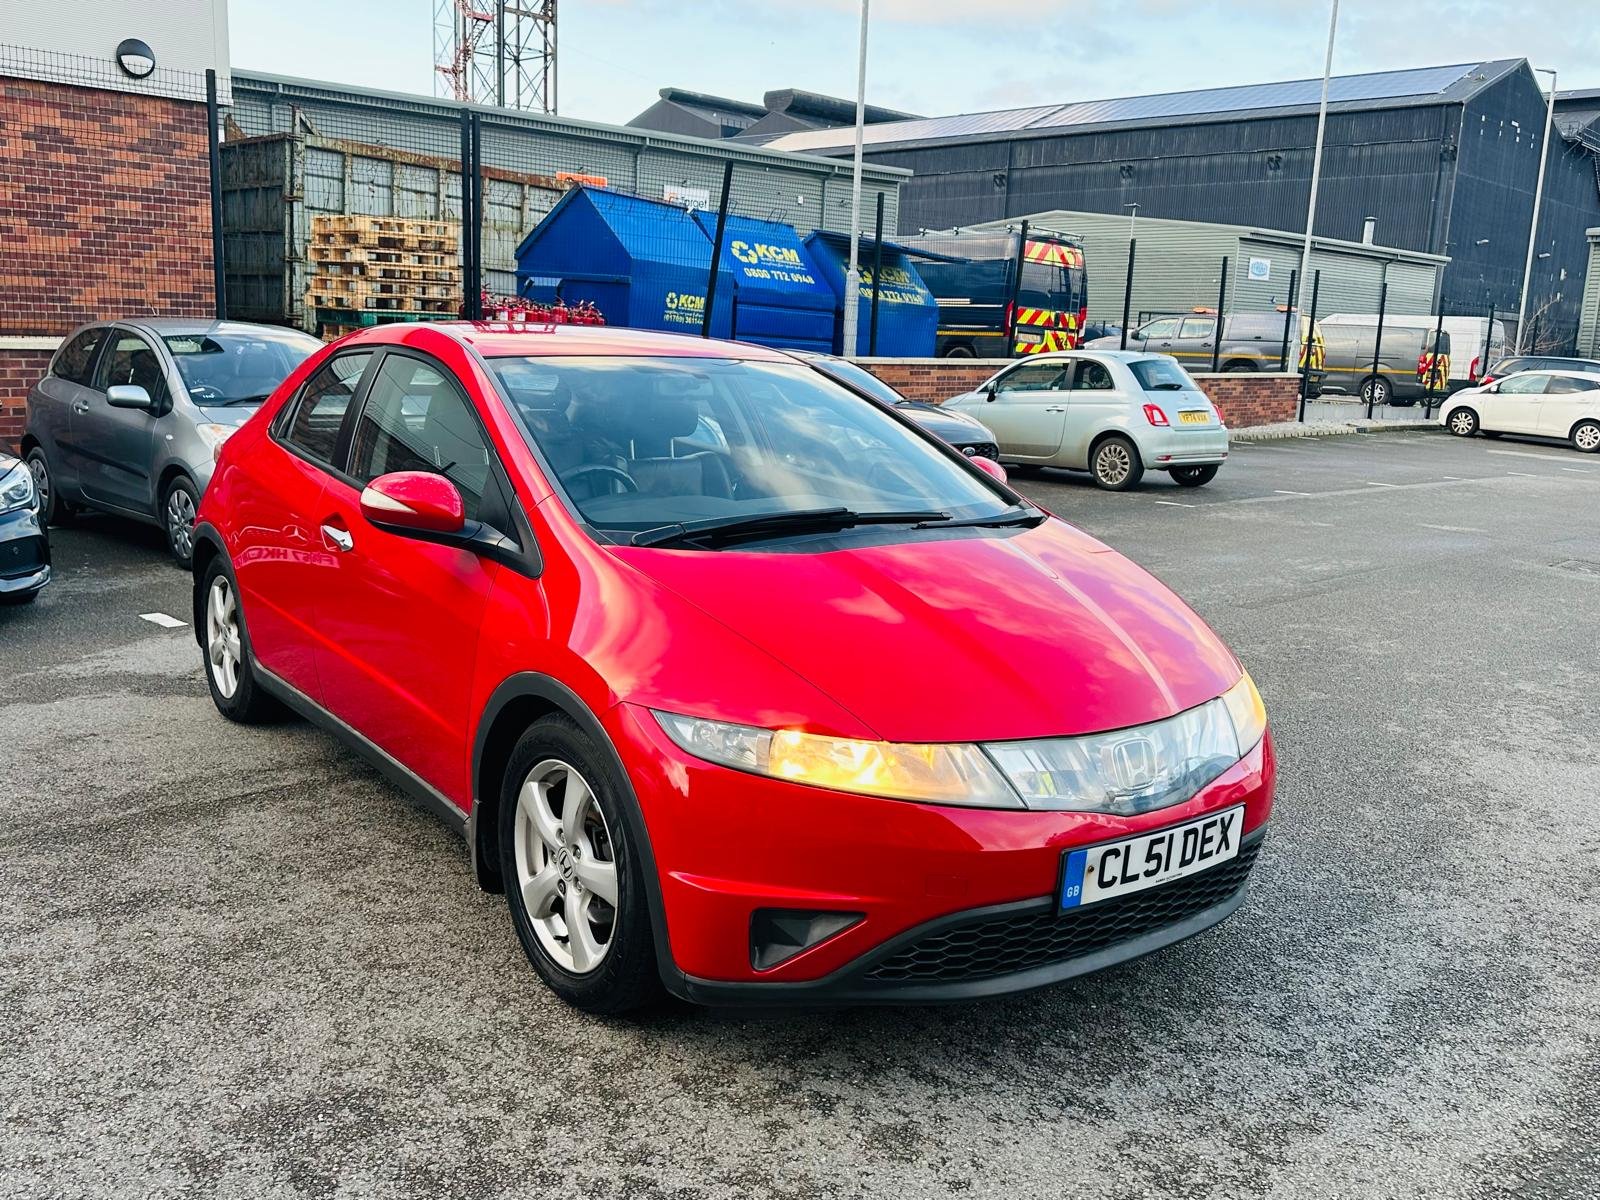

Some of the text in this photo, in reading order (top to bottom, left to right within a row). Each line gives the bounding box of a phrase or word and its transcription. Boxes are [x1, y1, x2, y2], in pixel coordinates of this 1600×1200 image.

[754, 243, 801, 262] KCM
[743, 267, 771, 279] 0800
[771, 270, 791, 282] 772
[678, 294, 706, 310] KCM
[1097, 813, 1235, 889] CL51 DEX
[1067, 885, 1080, 898] GB
